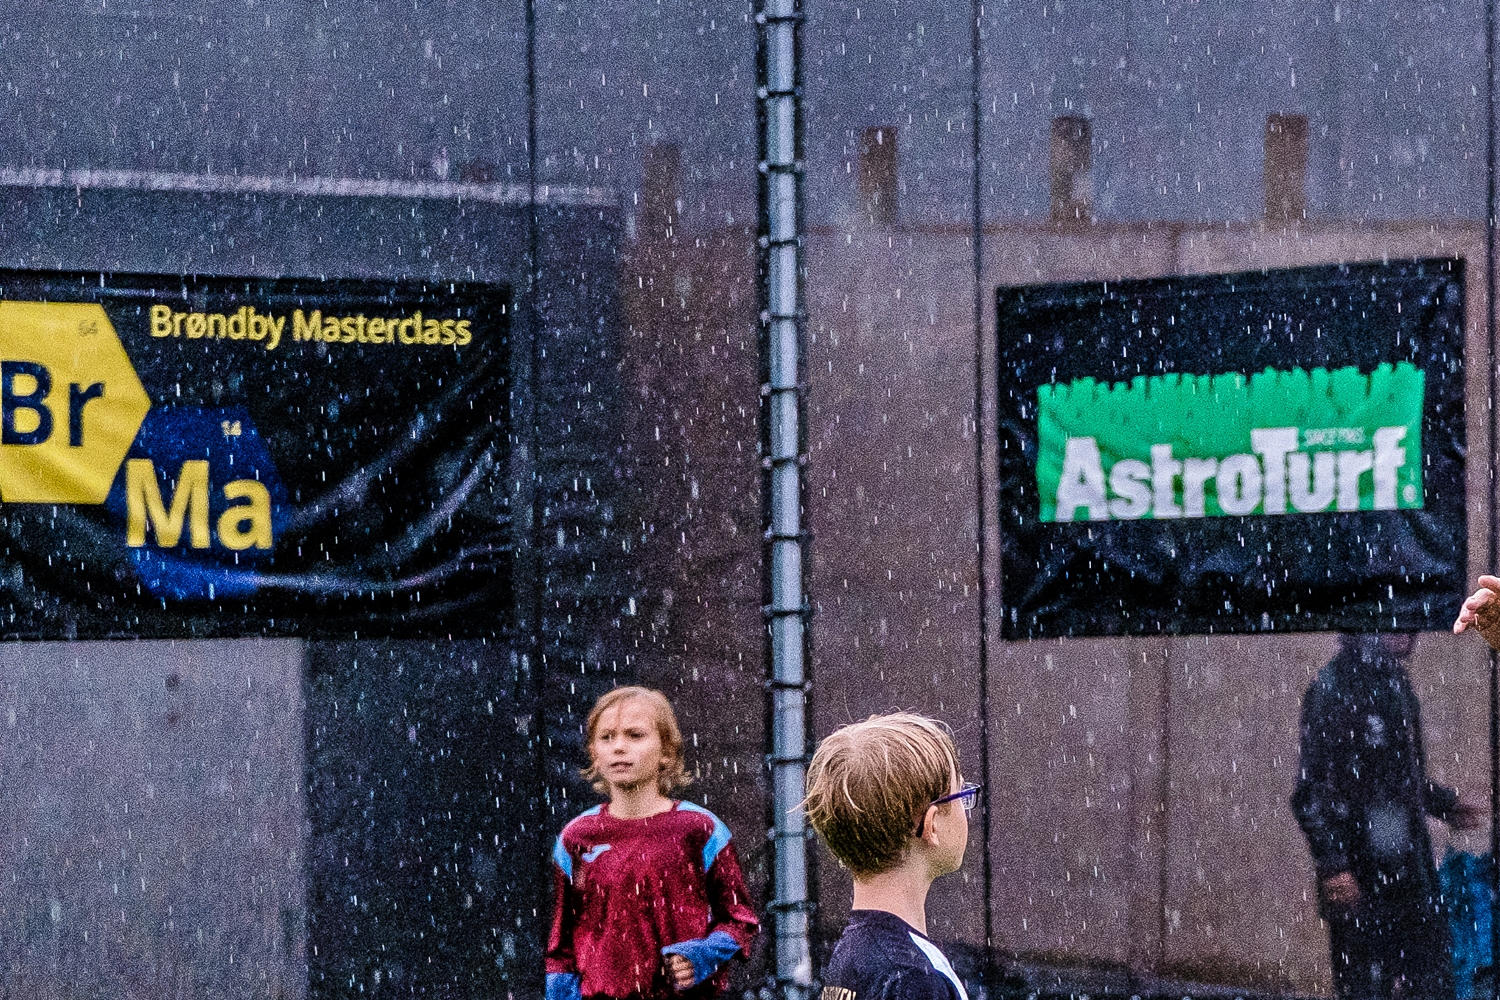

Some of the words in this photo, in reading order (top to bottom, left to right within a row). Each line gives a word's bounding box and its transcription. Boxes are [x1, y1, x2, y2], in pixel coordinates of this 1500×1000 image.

[150, 304, 284, 350] Brøndby
[292, 309, 472, 345] Masterclass
[0, 360, 104, 446] Br
[126, 459, 272, 549] Ma
[1055, 425, 1407, 522] AstroTurf
